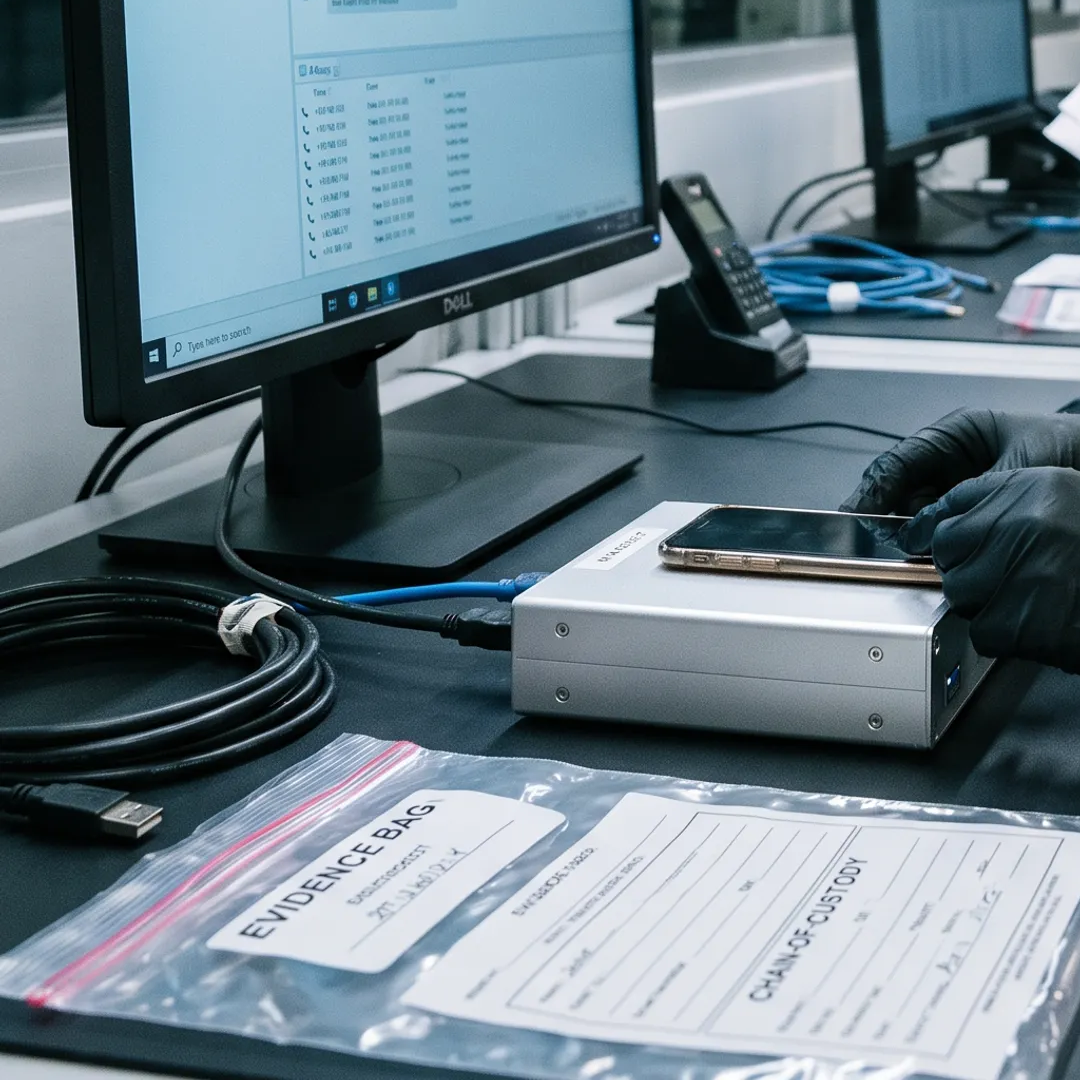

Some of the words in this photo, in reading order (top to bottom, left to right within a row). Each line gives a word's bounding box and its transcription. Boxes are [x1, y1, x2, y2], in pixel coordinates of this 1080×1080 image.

[221, 333, 229, 342] to
[443, 291, 474, 316] DELL
[238, 843, 385, 939] EVIDENCE
[371, 804, 436, 841] BAG
[749, 857, 868, 1002] CHAIN-OF-CUSTODY
